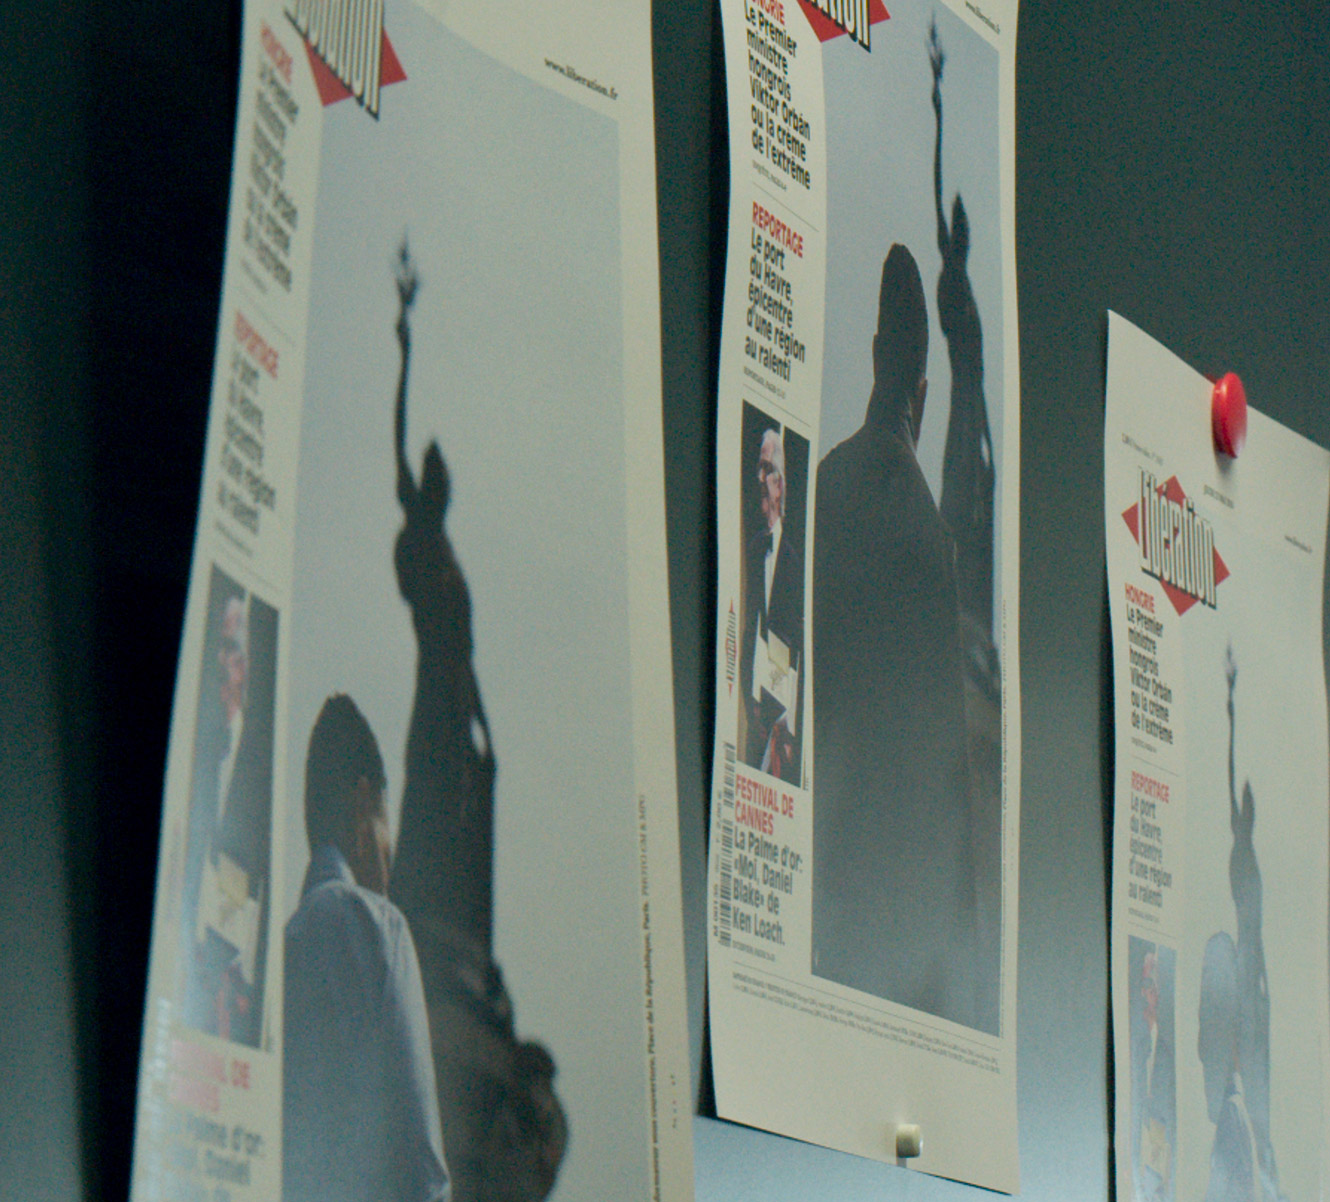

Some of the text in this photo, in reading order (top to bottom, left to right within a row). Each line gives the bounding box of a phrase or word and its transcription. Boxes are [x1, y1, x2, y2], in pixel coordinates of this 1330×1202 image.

[744, 0, 757, 27] Le
[757, 9, 797, 58] Premier
[746, 28, 788, 75] ministre
[748, 48, 791, 102] hongrois
[749, 74, 811, 141] Viktor Orbán
[751, 104, 807, 162] ou la crème
[752, 128, 764, 154] de
[751, 227, 785, 270] Le port
[753, 201, 803, 258] REPORTAGE
[748, 278, 793, 329] épicentre
[750, 254, 793, 306] du Havre,
[746, 304, 805, 363] d'une région
[745, 335, 757, 360] au
[759, 345, 791, 383] ralenti
[735, 800, 774, 836] CANNES
[736, 774, 794, 819] FESTIVAL DE
[734, 825, 745, 850] La
[748, 831, 779, 864] Palme
[762, 862, 793, 895] Daniel
[733, 906, 785, 946] Ken Loach.
[767, 890, 780, 916] de
